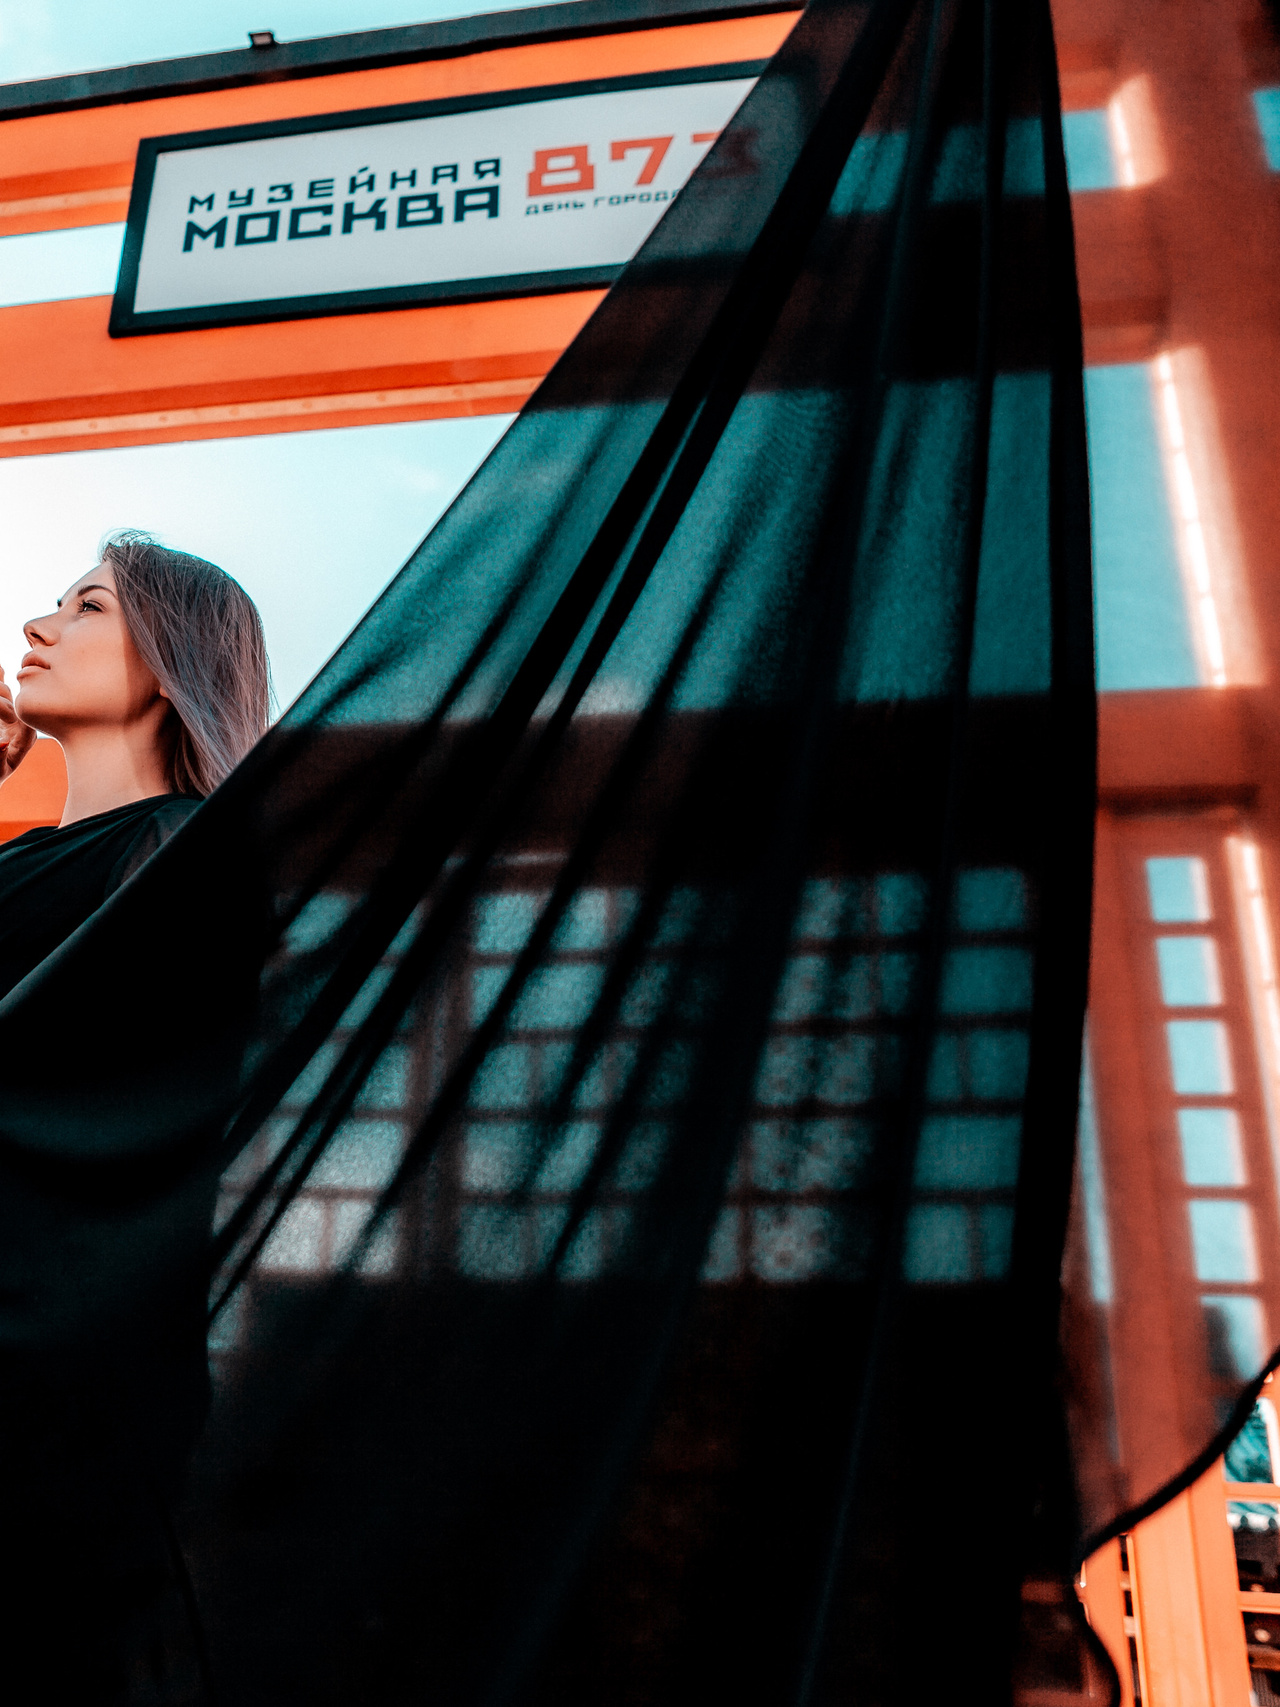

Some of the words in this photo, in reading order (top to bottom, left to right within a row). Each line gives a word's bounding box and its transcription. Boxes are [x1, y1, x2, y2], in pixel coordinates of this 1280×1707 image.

[189, 158, 501, 213] МУЗЕЙНАЯ
[525, 200, 586, 215] ДЕНЬ
[182, 184, 500, 252] МОСКВА
